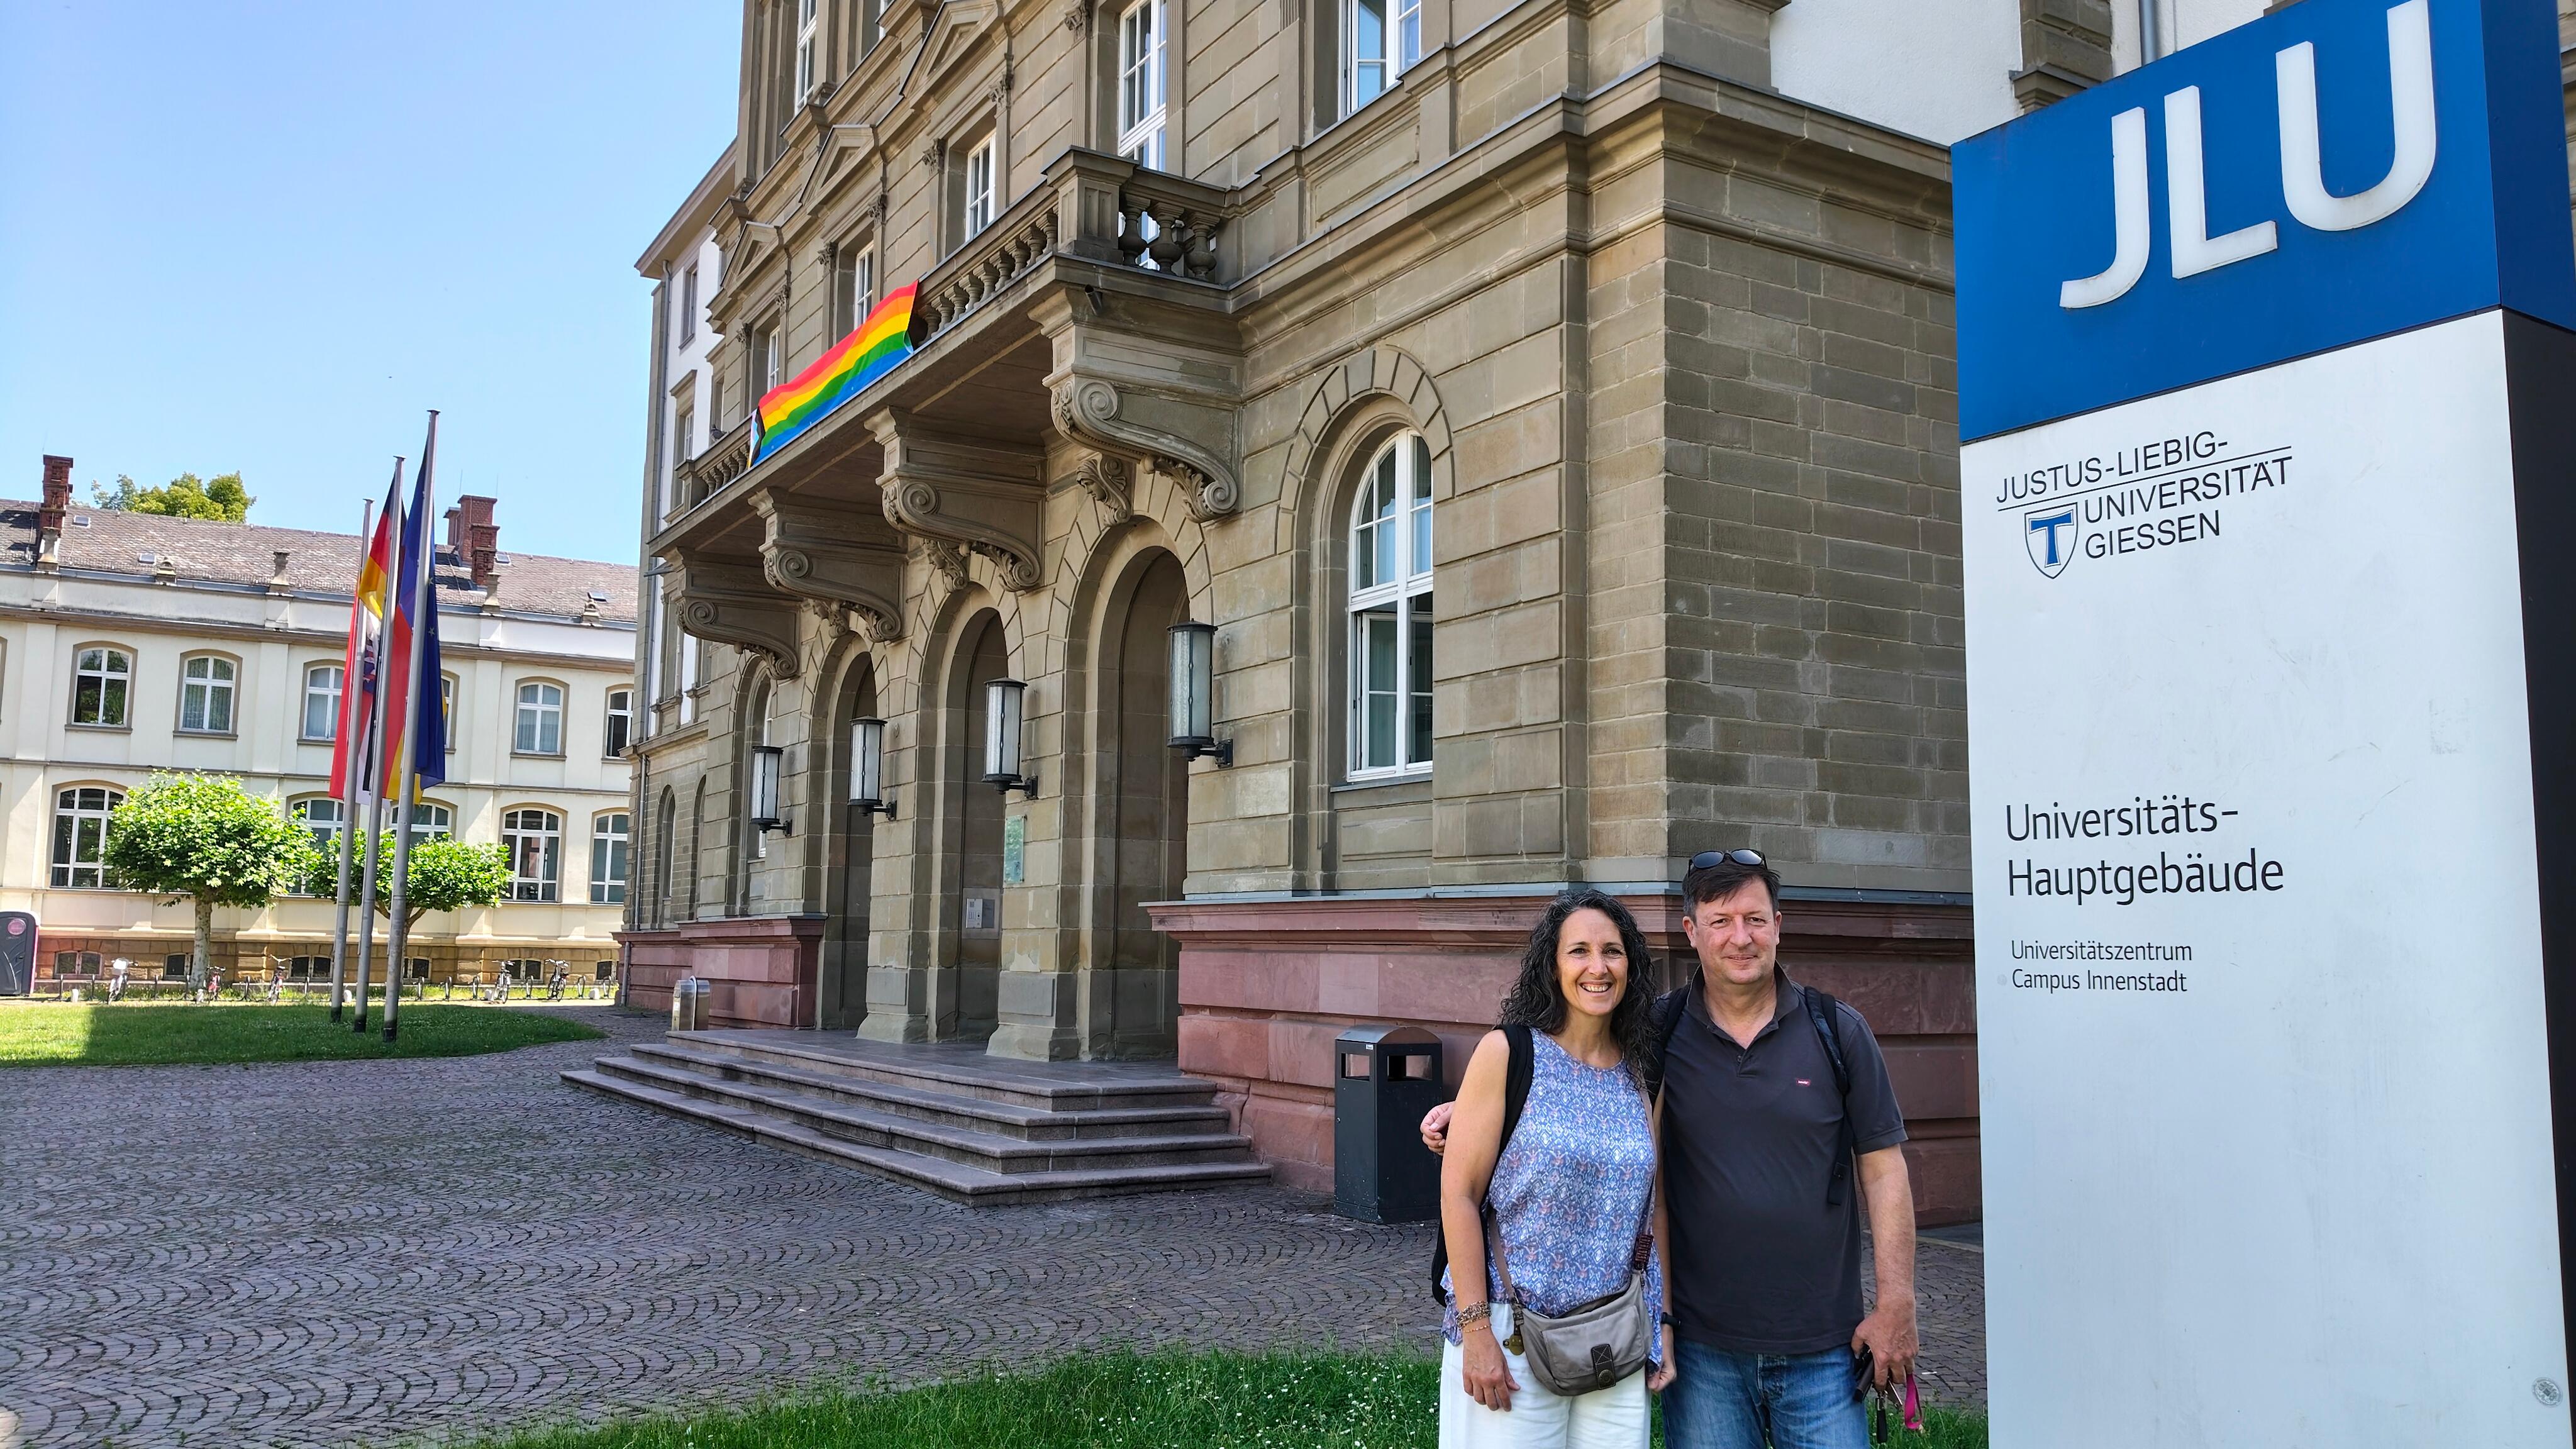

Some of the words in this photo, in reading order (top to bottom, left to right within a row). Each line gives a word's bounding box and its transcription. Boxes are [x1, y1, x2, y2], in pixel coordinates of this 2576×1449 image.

[2059, 0, 2436, 309] JLU
[1996, 430, 2228, 503] JUSTUS-LIEBIG-
[2084, 455, 2293, 524] UNIVERSITÄT
[2085, 509, 2221, 560] GIESSEN
[2006, 794, 2238, 841] Universitäts-
[2008, 847, 2284, 906] Hauptgebäude
[2011, 940, 2192, 961] Universitätszentrum
[2012, 969, 2080, 994] Campus
[2087, 969, 2188, 992] Innenstadt
